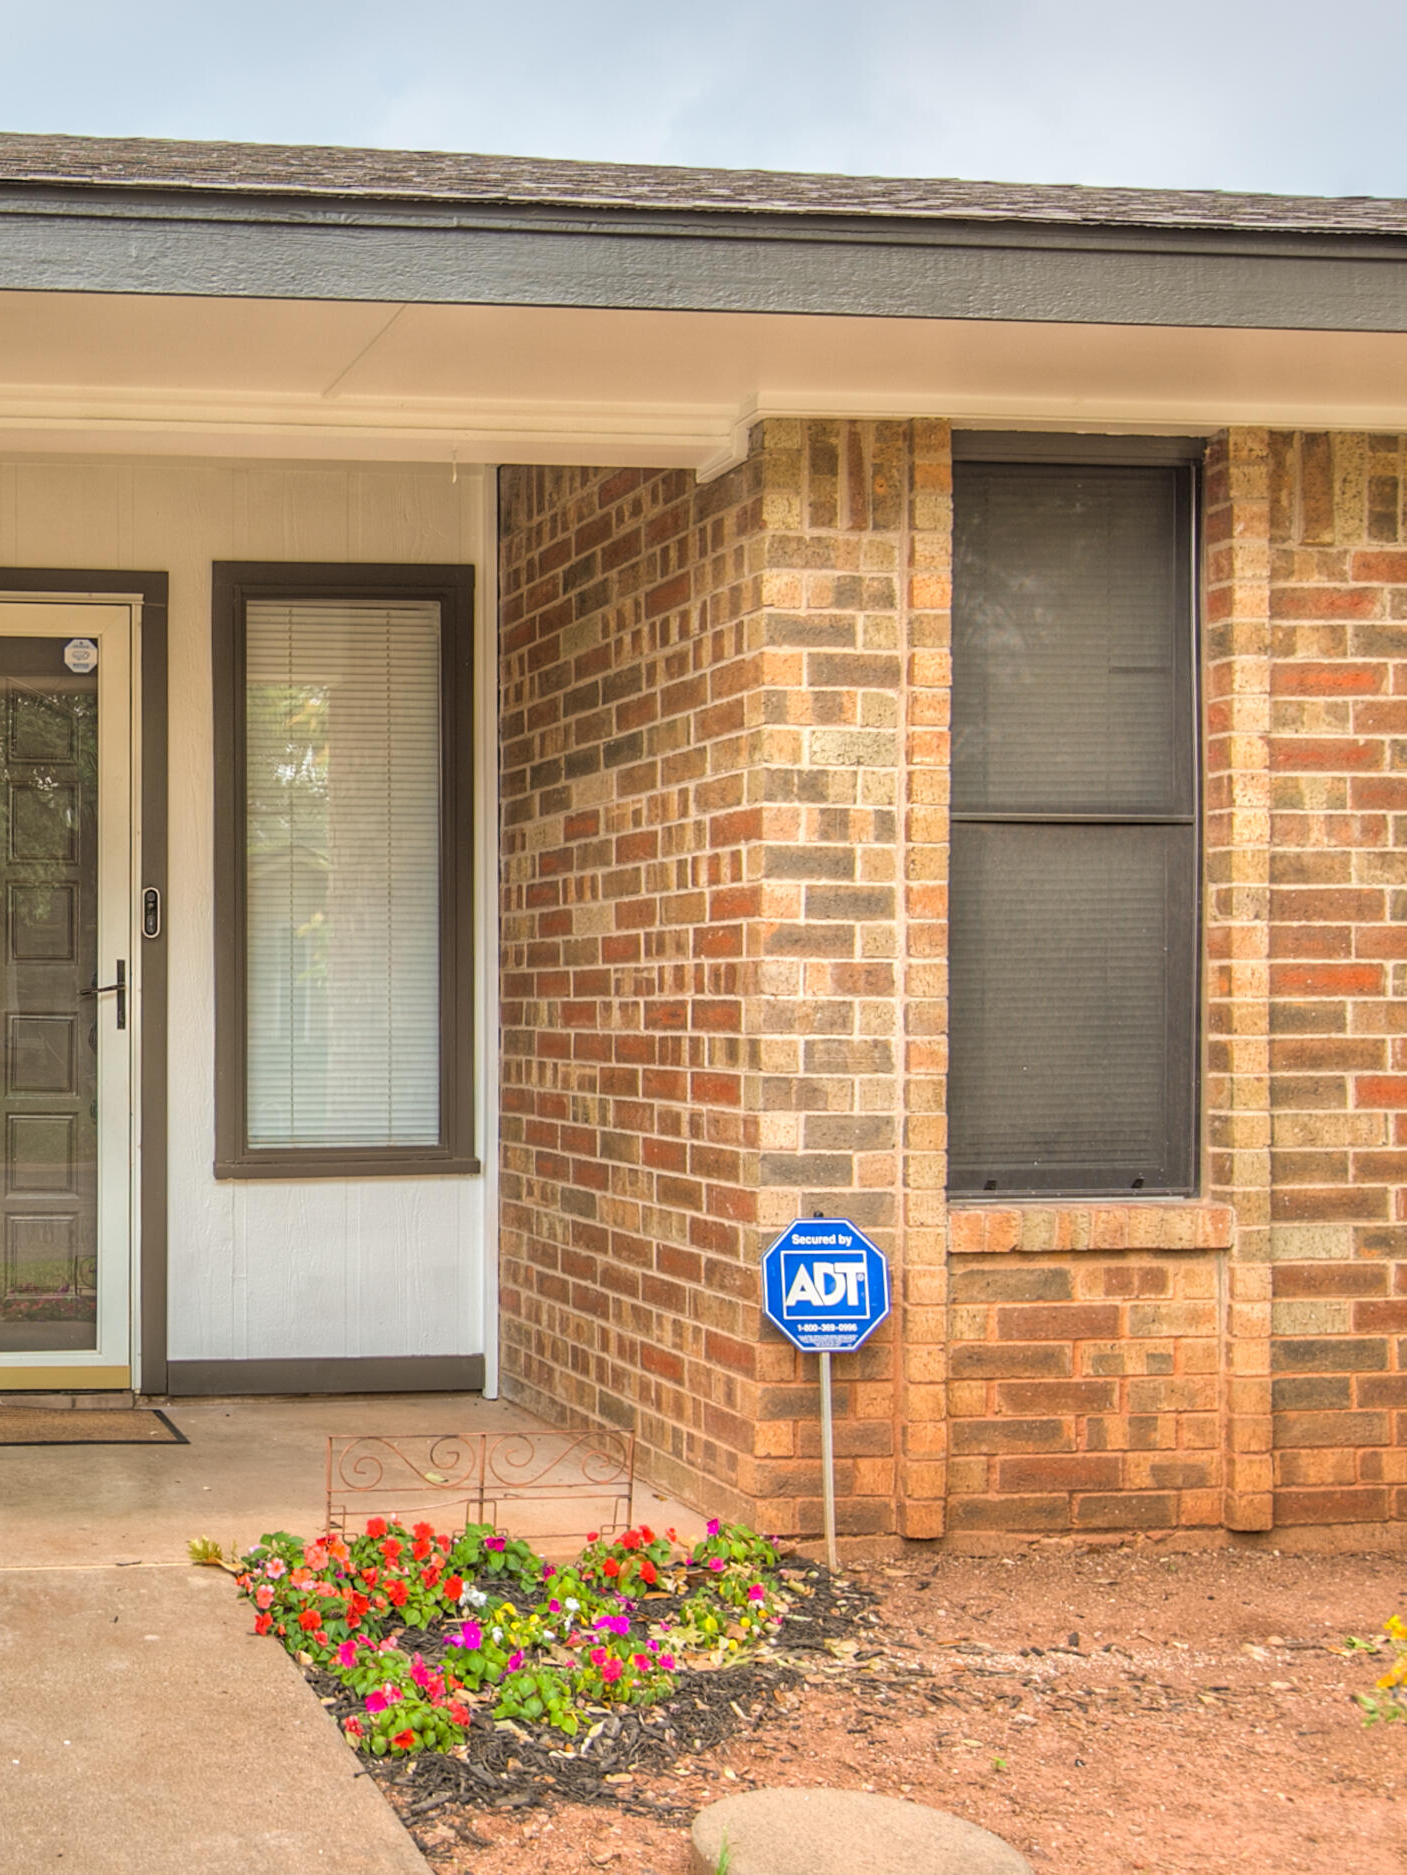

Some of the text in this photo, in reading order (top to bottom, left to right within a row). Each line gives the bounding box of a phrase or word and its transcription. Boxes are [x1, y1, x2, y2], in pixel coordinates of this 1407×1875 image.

[791, 1233, 853, 1247] Secured by
[785, 1261, 866, 1307] ADT
